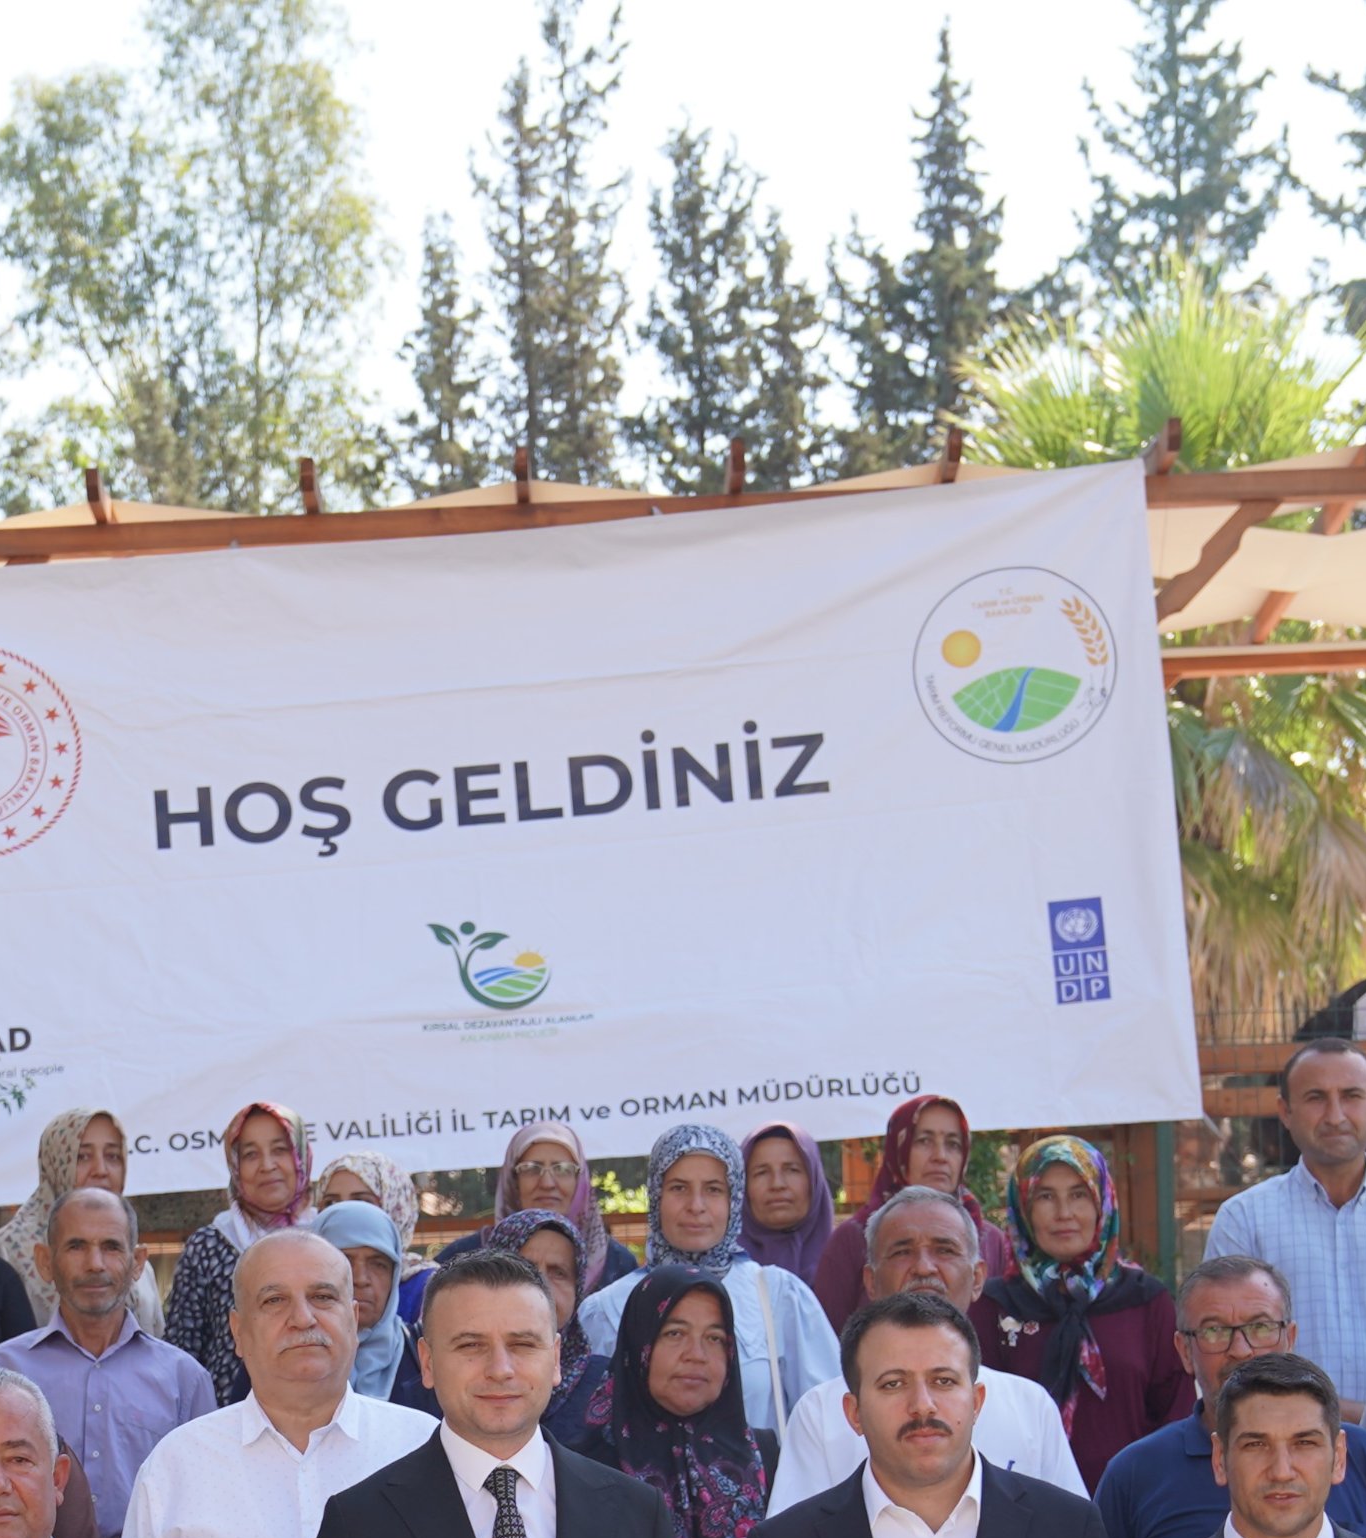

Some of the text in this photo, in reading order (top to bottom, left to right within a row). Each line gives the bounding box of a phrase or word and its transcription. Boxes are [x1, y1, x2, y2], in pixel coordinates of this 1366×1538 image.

[13, 704, 42, 754] ORMAN
[153, 719, 830, 858] HOŞ GELDİNİZ
[21, 1063, 65, 1079] people
[325, 1110, 443, 1142] VALİLİĞİ
[452, 1108, 476, 1132] İL
[483, 1104, 571, 1131] TARIM
[580, 1105, 611, 1121] ve
[620, 1088, 728, 1118] ORMAN
[736, 1071, 923, 1107] MÜDÜRLÜĞÜ
